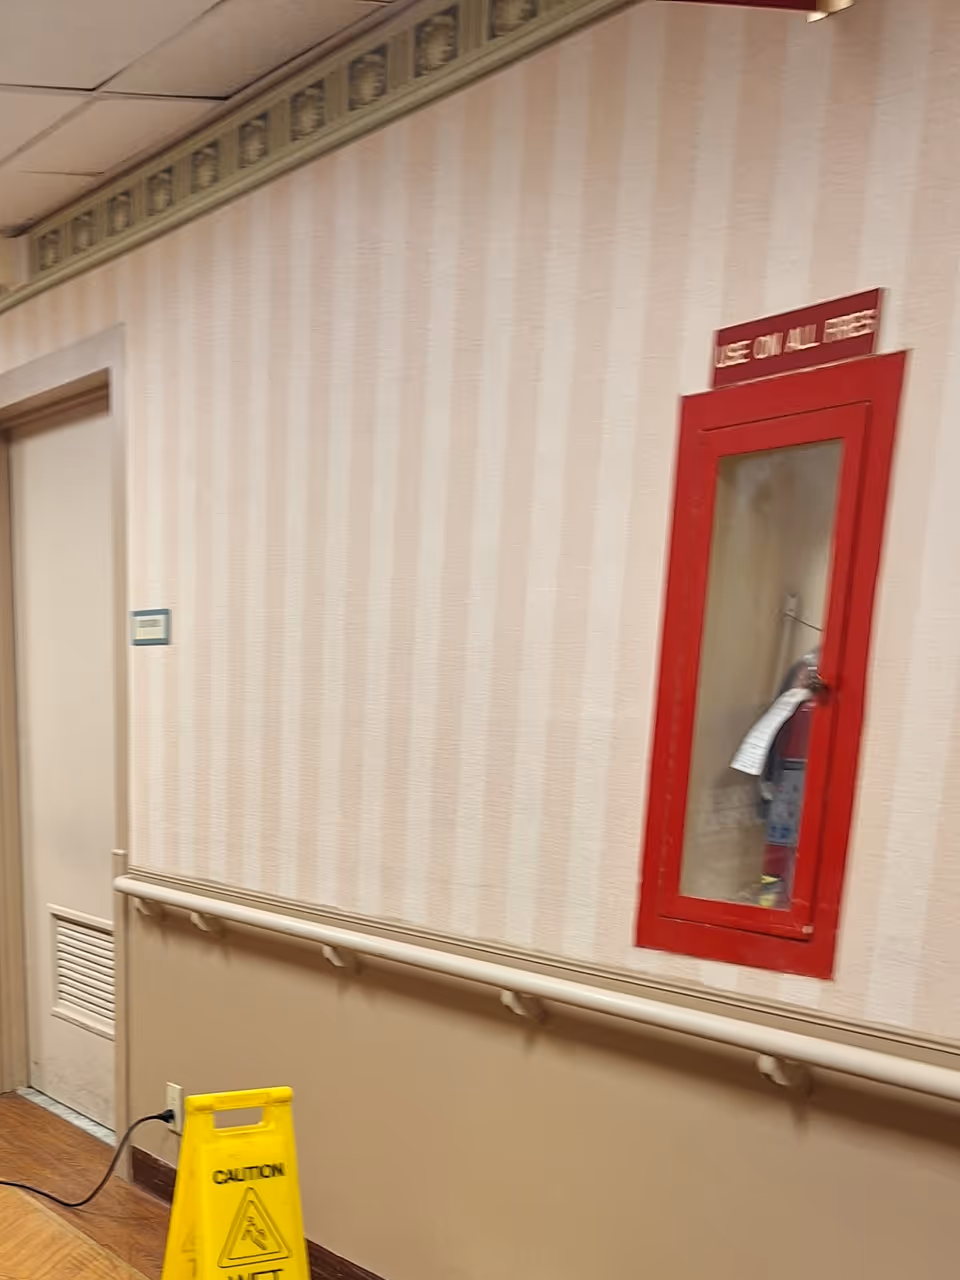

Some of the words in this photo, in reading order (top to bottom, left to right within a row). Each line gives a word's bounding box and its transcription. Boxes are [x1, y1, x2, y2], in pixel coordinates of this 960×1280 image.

[753, 332, 784, 359] ON
[784, 323, 820, 353] ALL
[212, 1162, 285, 1186] CAUTION
